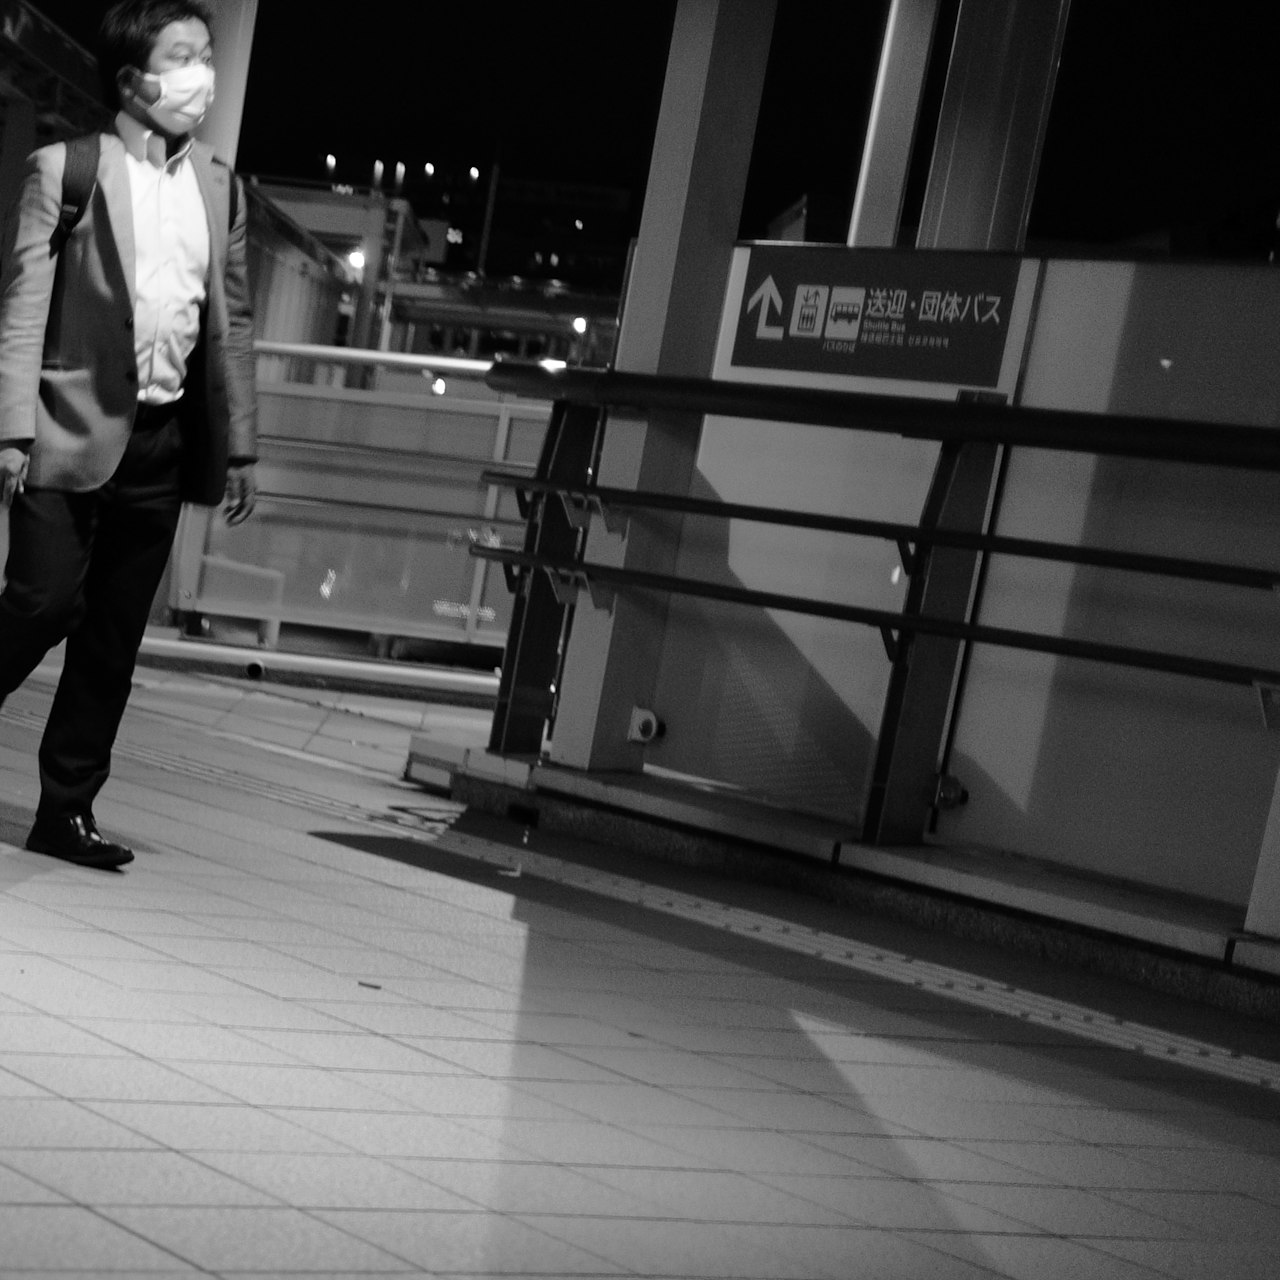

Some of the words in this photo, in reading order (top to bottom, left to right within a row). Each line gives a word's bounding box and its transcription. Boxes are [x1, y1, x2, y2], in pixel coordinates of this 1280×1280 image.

[865, 288, 1001, 324] 送迎・団体バス
